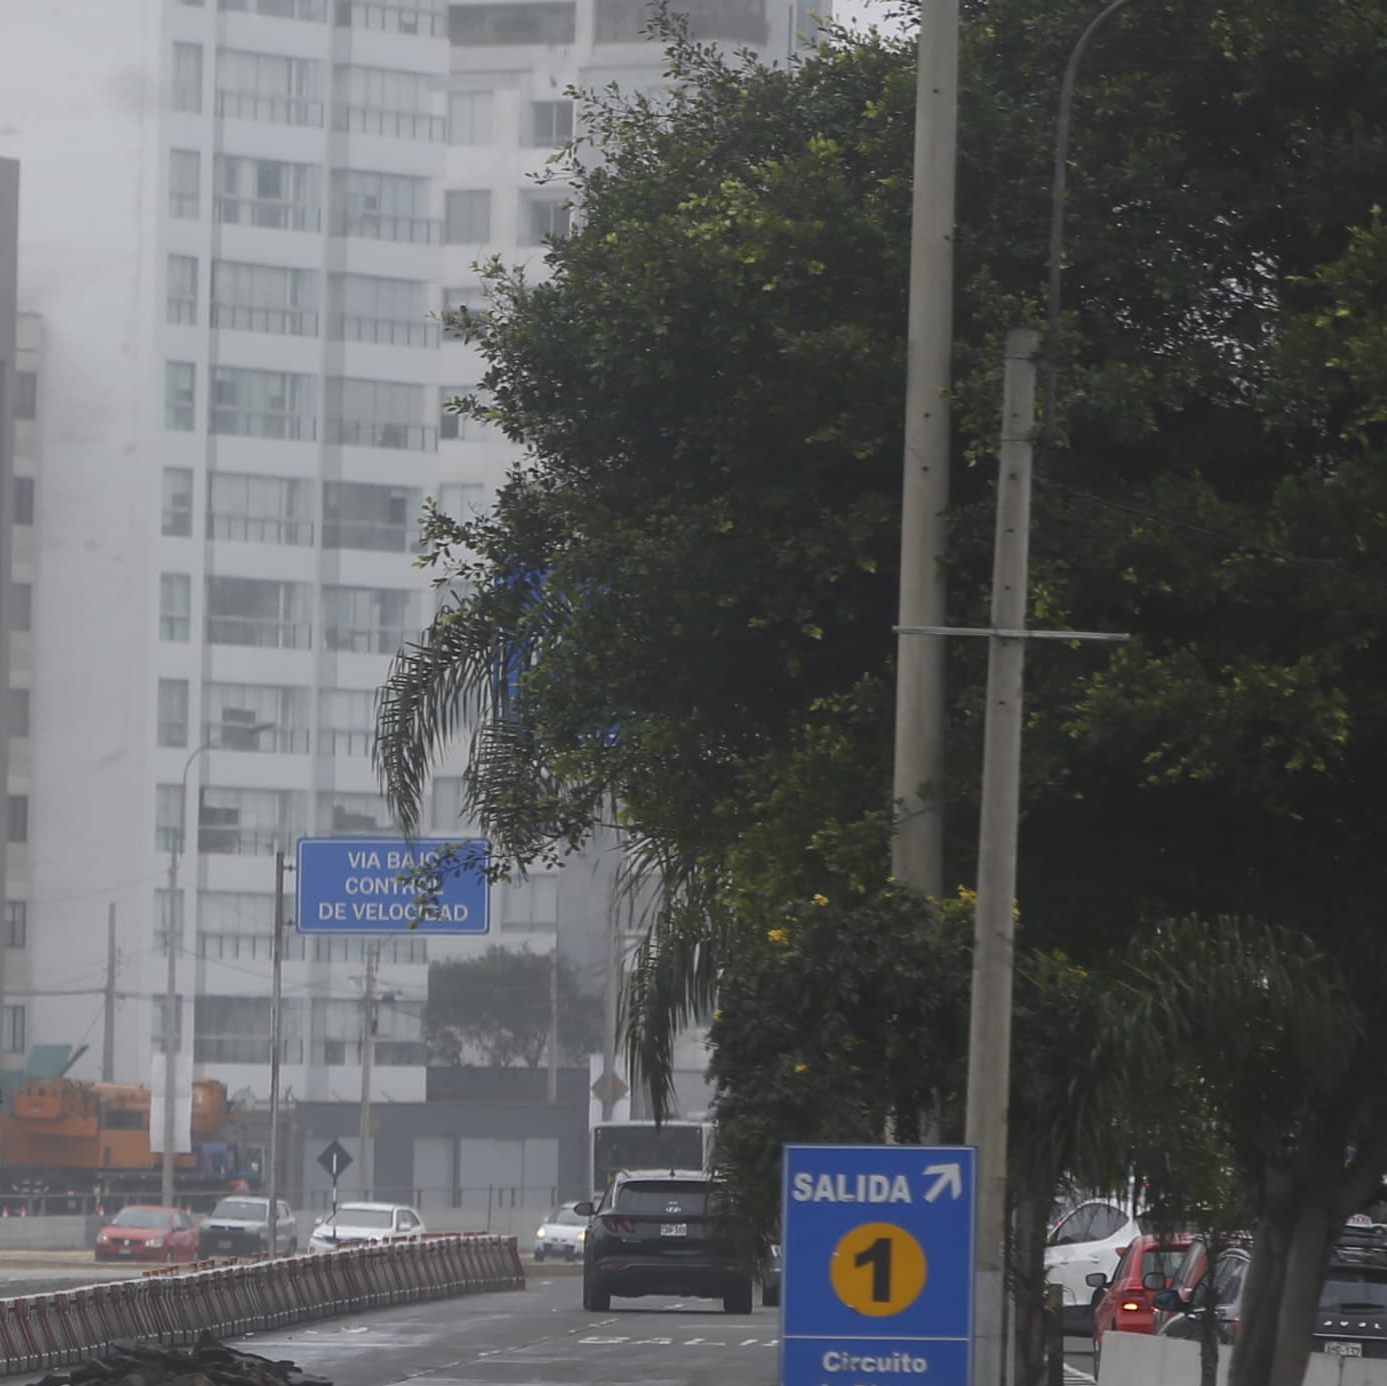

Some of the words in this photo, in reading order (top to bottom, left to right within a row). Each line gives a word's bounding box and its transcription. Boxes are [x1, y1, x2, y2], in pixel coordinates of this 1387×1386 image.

[347, 850, 381, 870] VIA
[318, 902, 347, 921] DE
[792, 1172, 913, 1204] SALIDA
[853, 1237, 893, 1304] 1
[822, 1351, 928, 1374] Circuito
